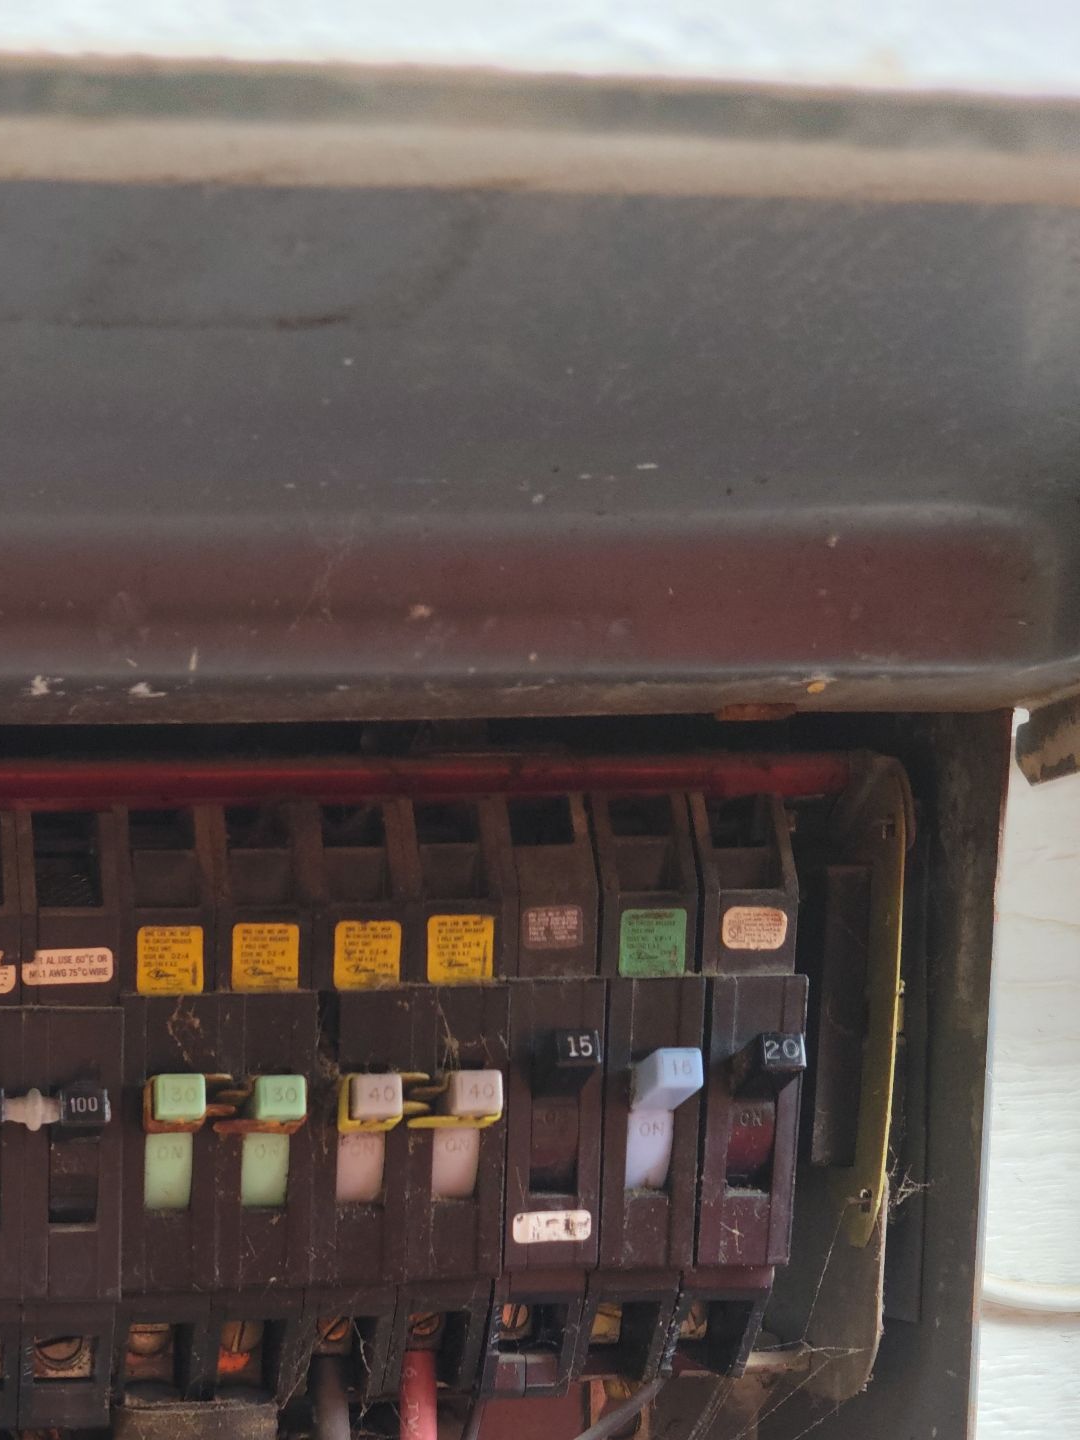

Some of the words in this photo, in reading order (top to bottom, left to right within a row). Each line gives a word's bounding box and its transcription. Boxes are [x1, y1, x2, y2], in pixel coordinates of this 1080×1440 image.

[97, 953, 108, 964] OR
[49, 968, 67, 978] AWG
[88, 966, 109, 977] WIRE
[568, 1036, 592, 1057] 15
[764, 1039, 800, 1060] 20
[273, 1087, 298, 1101] 30
[369, 1086, 396, 1101] 40
[469, 1084, 495, 1098] 40
[69, 1096, 98, 1113] 100
[639, 1121, 665, 1138] ON
